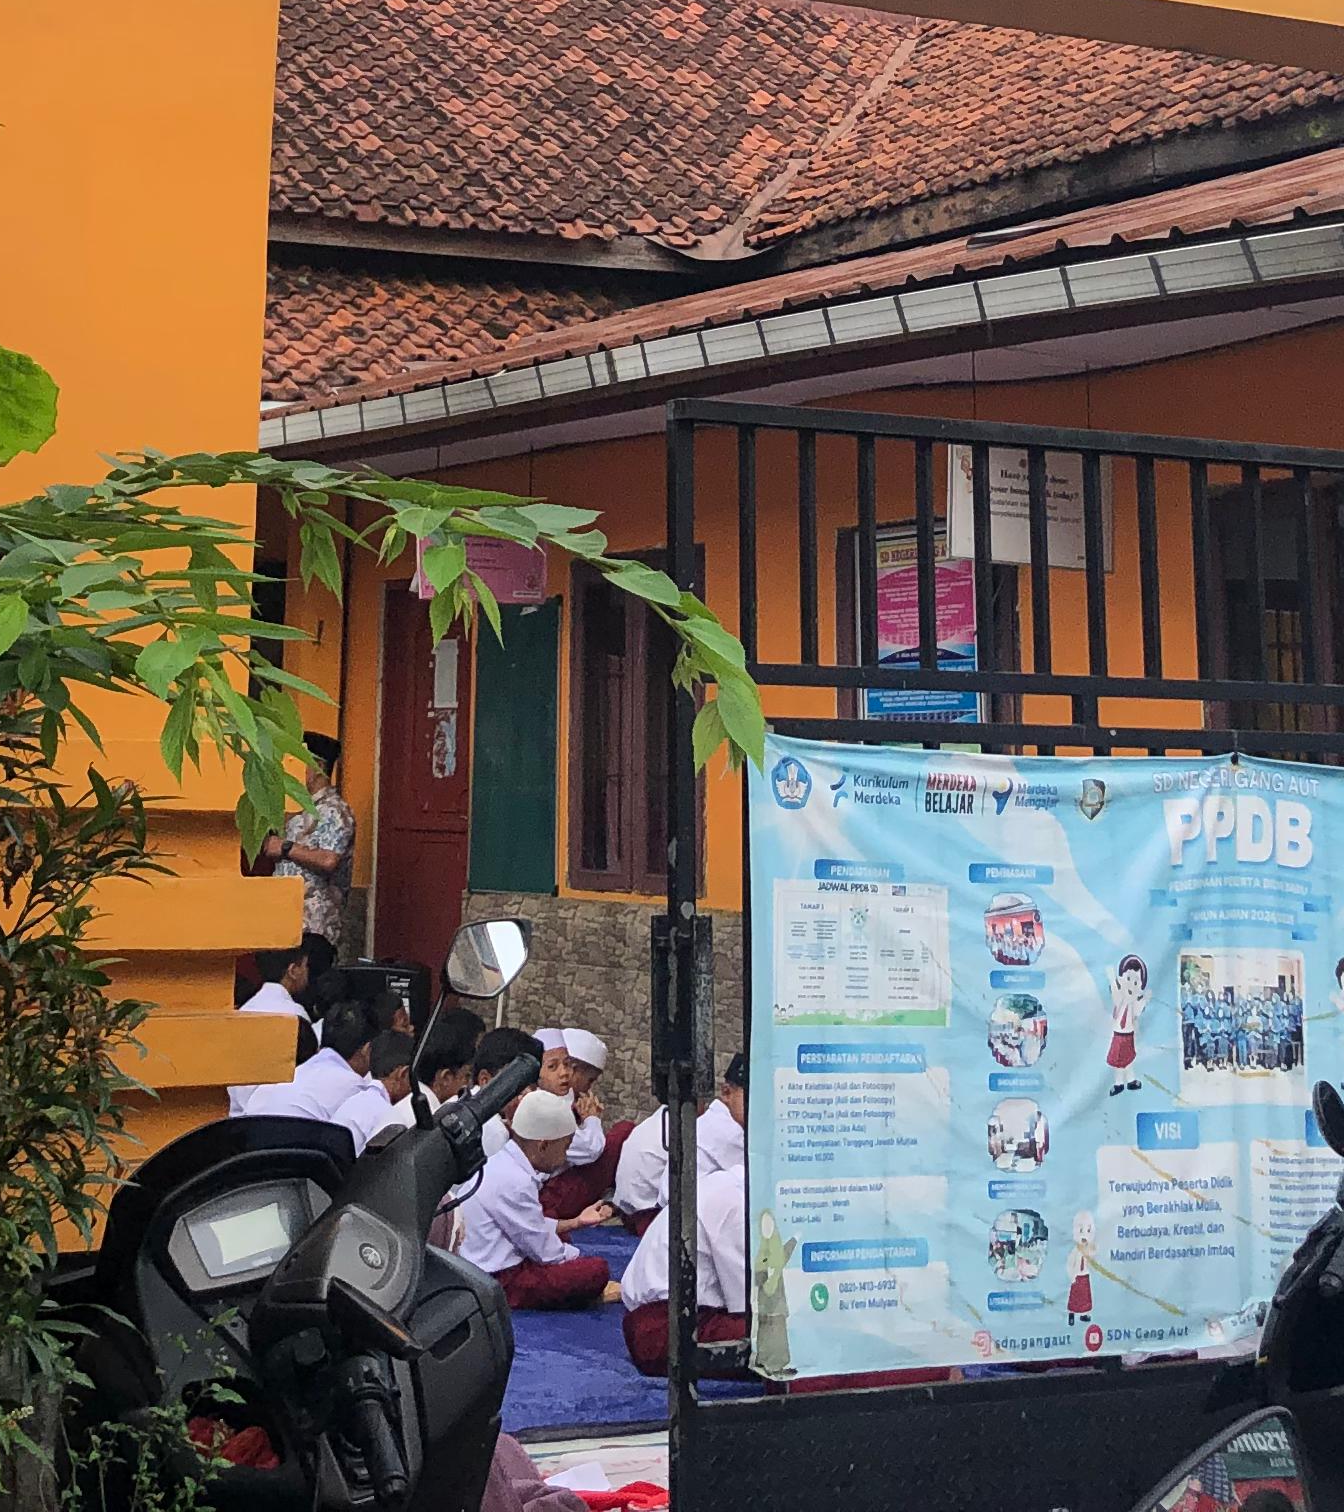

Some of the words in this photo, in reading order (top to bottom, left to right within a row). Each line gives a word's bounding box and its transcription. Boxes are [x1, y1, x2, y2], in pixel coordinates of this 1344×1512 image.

[853, 774, 909, 789] Kurikulum
[926, 772, 977, 794] MERDEKA
[1152, 772, 1174, 793] SD
[1234, 768, 1284, 793] GANG
[1289, 775, 1320, 798] AUT
[854, 790, 901, 806] Merdeka
[925, 792, 974, 815] BELAJAR
[1163, 795, 1313, 868] PPDB
[818, 882, 848, 892] JADWAL
[1155, 1122, 1181, 1141] VISI
[1109, 1180, 1170, 1193] Terwujudnya
[1171, 1177, 1209, 1190] Peserta
[1210, 1176, 1233, 1189] Didik
[1122, 1205, 1143, 1218] yang
[1146, 1201, 1193, 1215] Berakhlak
[1207, 1222, 1224, 1234] dan
[1110, 1248, 1146, 1261] Mandiri
[1148, 1247, 1206, 1261] Berdasarkan
[1207, 1245, 1235, 1258] Imtaq
[1106, 1328, 1131, 1341] SDN
[1135, 1327, 1164, 1341] Gang
[1169, 1325, 1188, 1337] Aut
[995, 1333, 1071, 1351] sdn.gangaut
